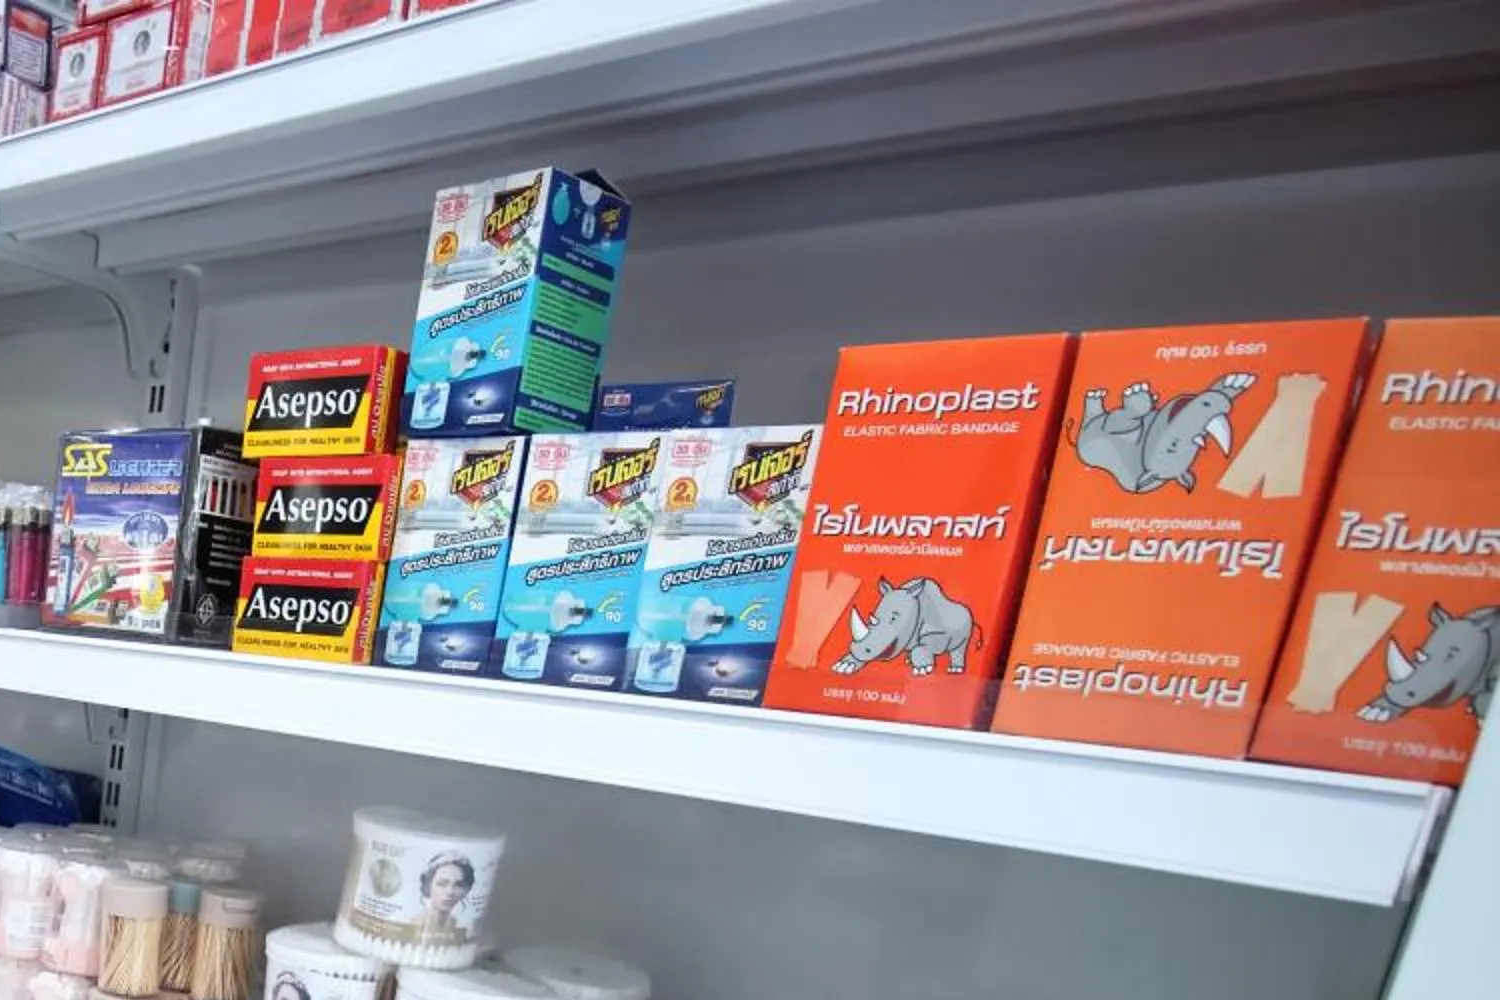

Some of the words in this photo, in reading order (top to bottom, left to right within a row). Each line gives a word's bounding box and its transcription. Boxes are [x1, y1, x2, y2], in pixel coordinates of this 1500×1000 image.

[1190, 344, 1219, 359] 100
[256, 386, 359, 429] Asepso
[837, 382, 1041, 419] Rhinoplast
[843, 424, 896, 437] ELASTIC
[899, 422, 949, 436] FABRIC
[950, 421, 1020, 434] BANDAGE
[1389, 416, 1469, 431] ELASTIC
[61, 443, 113, 476] SAS
[265, 488, 368, 533] Asepso
[812, 504, 1011, 539] ไรโนพลาสท์
[1039, 535, 1285, 580] ไรโนพลาสท์
[247, 586, 349, 632] Asepso
[1033, 642, 1105, 657] BANDAGE
[1109, 646, 1166, 662] FABRIC
[1171, 651, 1240, 667] ELASTIC
[857, 689, 880, 702] 100
[1014, 662, 1249, 709] Rhinoplast
[1393, 740, 1426, 757] 100
